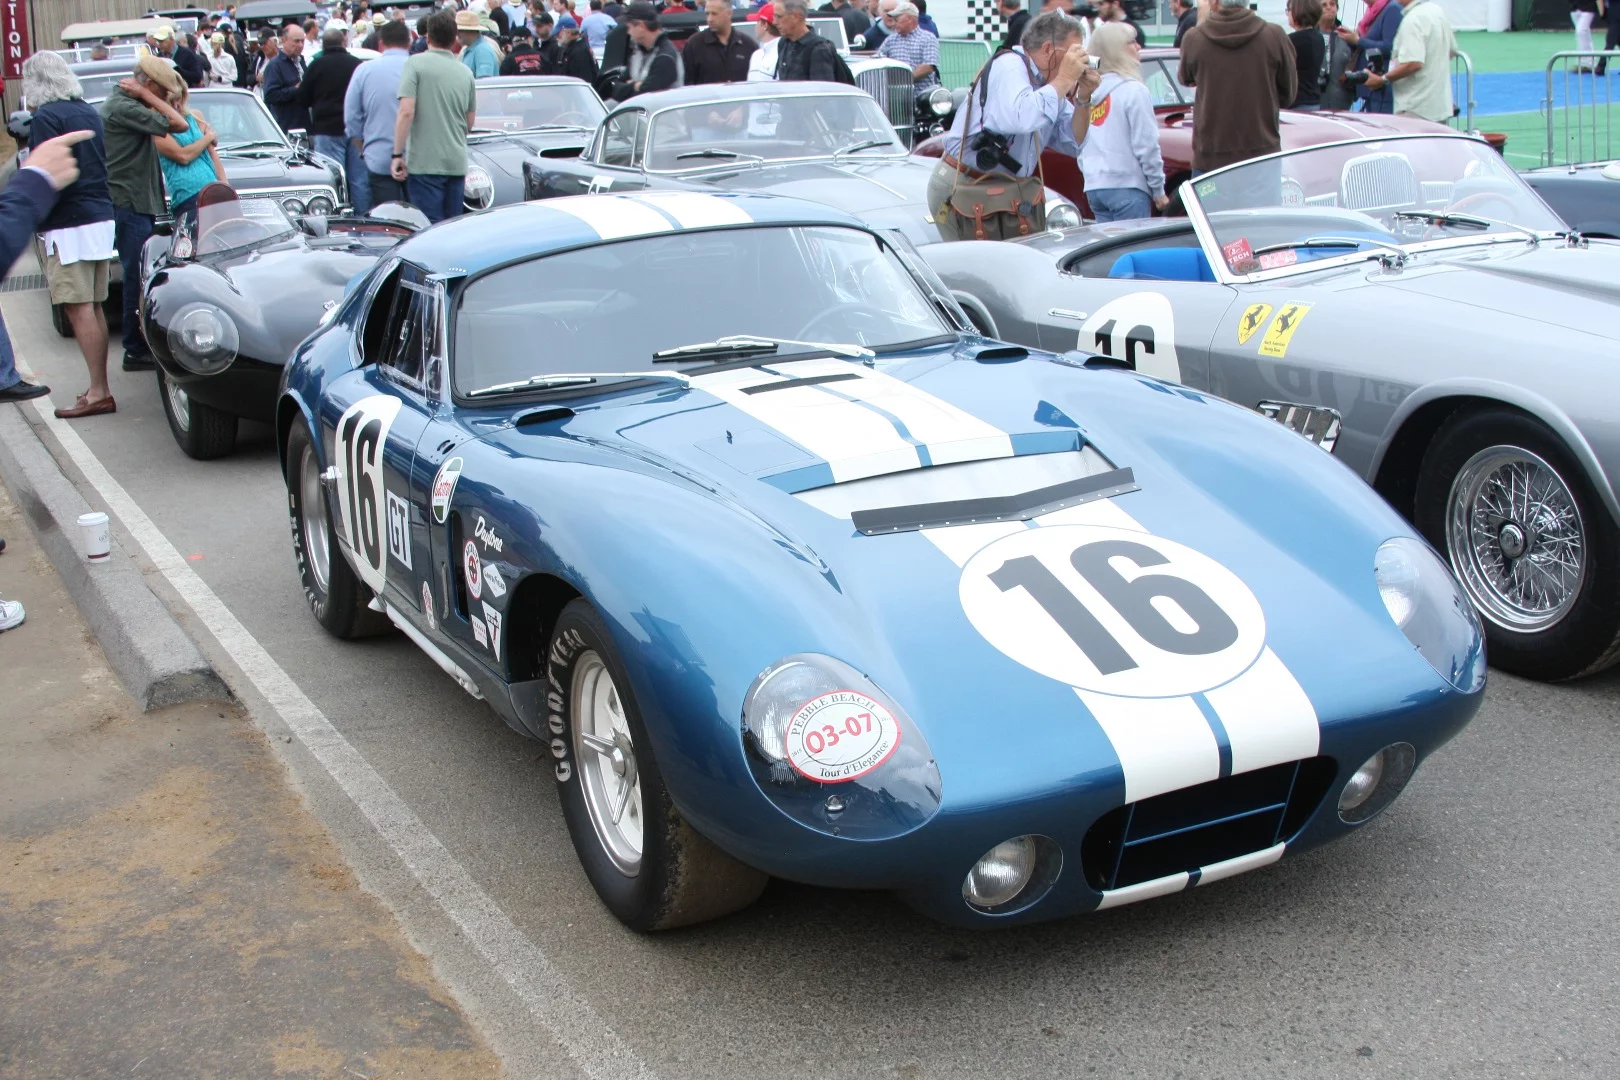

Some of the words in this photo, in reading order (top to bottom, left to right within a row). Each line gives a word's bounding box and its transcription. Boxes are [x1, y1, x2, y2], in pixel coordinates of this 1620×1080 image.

[8, 0, 22, 58] TION
[1227, 251, 1250, 265] TECH
[342, 409, 382, 571] 16
[389, 497, 407, 562] GT
[474, 515, 503, 553] Daytona
[987, 540, 1239, 676] 16
[791, 697, 829, 736] PEBBLE
[831, 693, 877, 710] BEACH
[805, 712, 872, 754] 03-07
[820, 767, 842, 778] Tour
